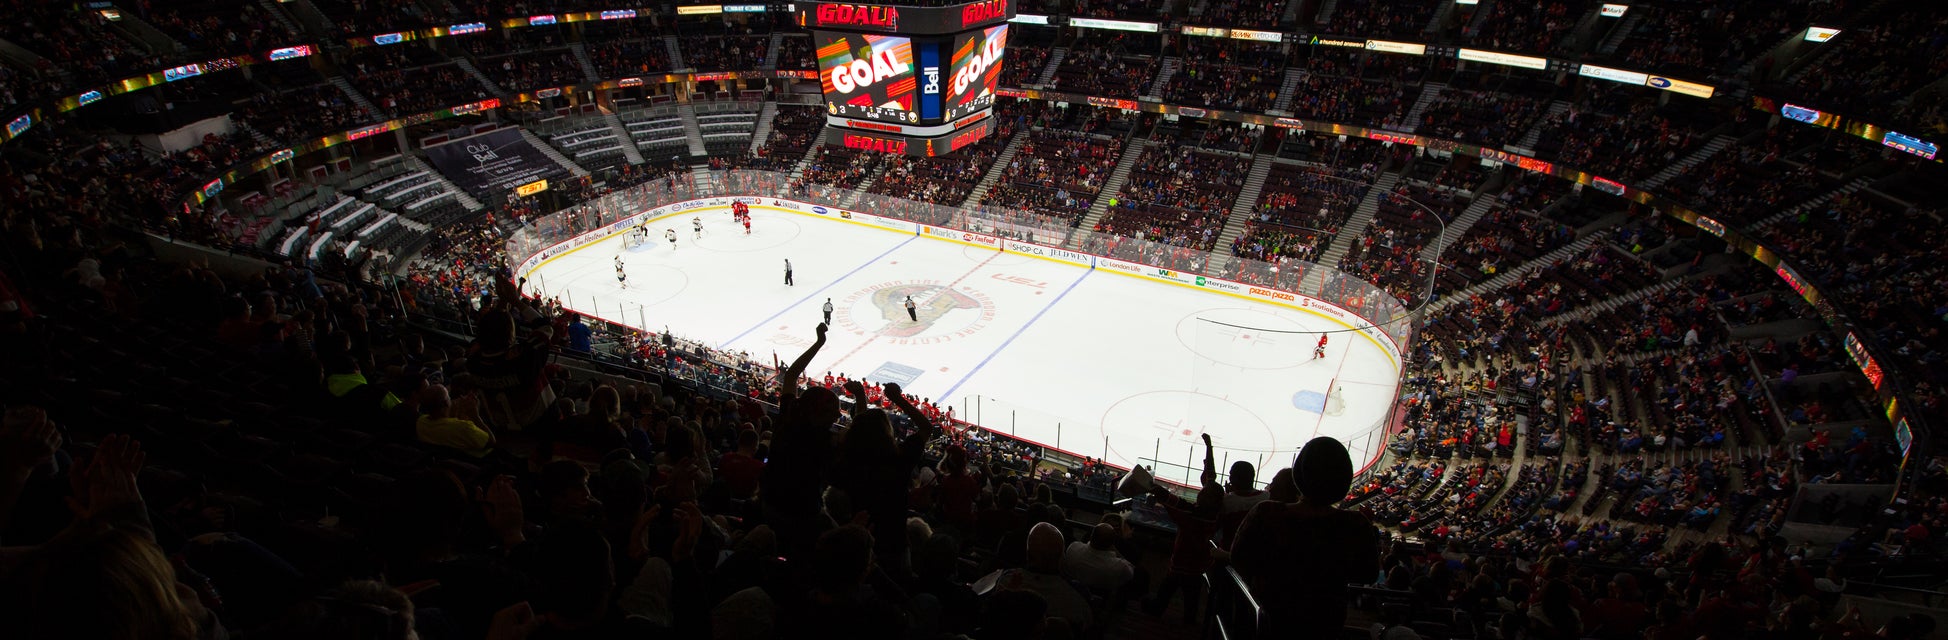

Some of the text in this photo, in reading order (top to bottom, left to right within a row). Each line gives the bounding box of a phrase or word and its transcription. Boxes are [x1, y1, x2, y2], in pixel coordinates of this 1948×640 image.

[831, 49, 909, 94] GOAL
[954, 38, 1002, 96] GOAL
[924, 66, 939, 94] Bell
[840, 105, 846, 113] 3
[899, 112, 906, 120] 5
[466, 143, 490, 154] Club
[473, 150, 499, 162] Bell
[522, 182, 542, 194] TSN
[930, 227, 957, 239] Mark's
[1109, 261, 1130, 271] London
[1158, 269, 1178, 278] WM
[1249, 287, 1295, 302] pizza pizza
[1311, 301, 1345, 318] Scotiabank
